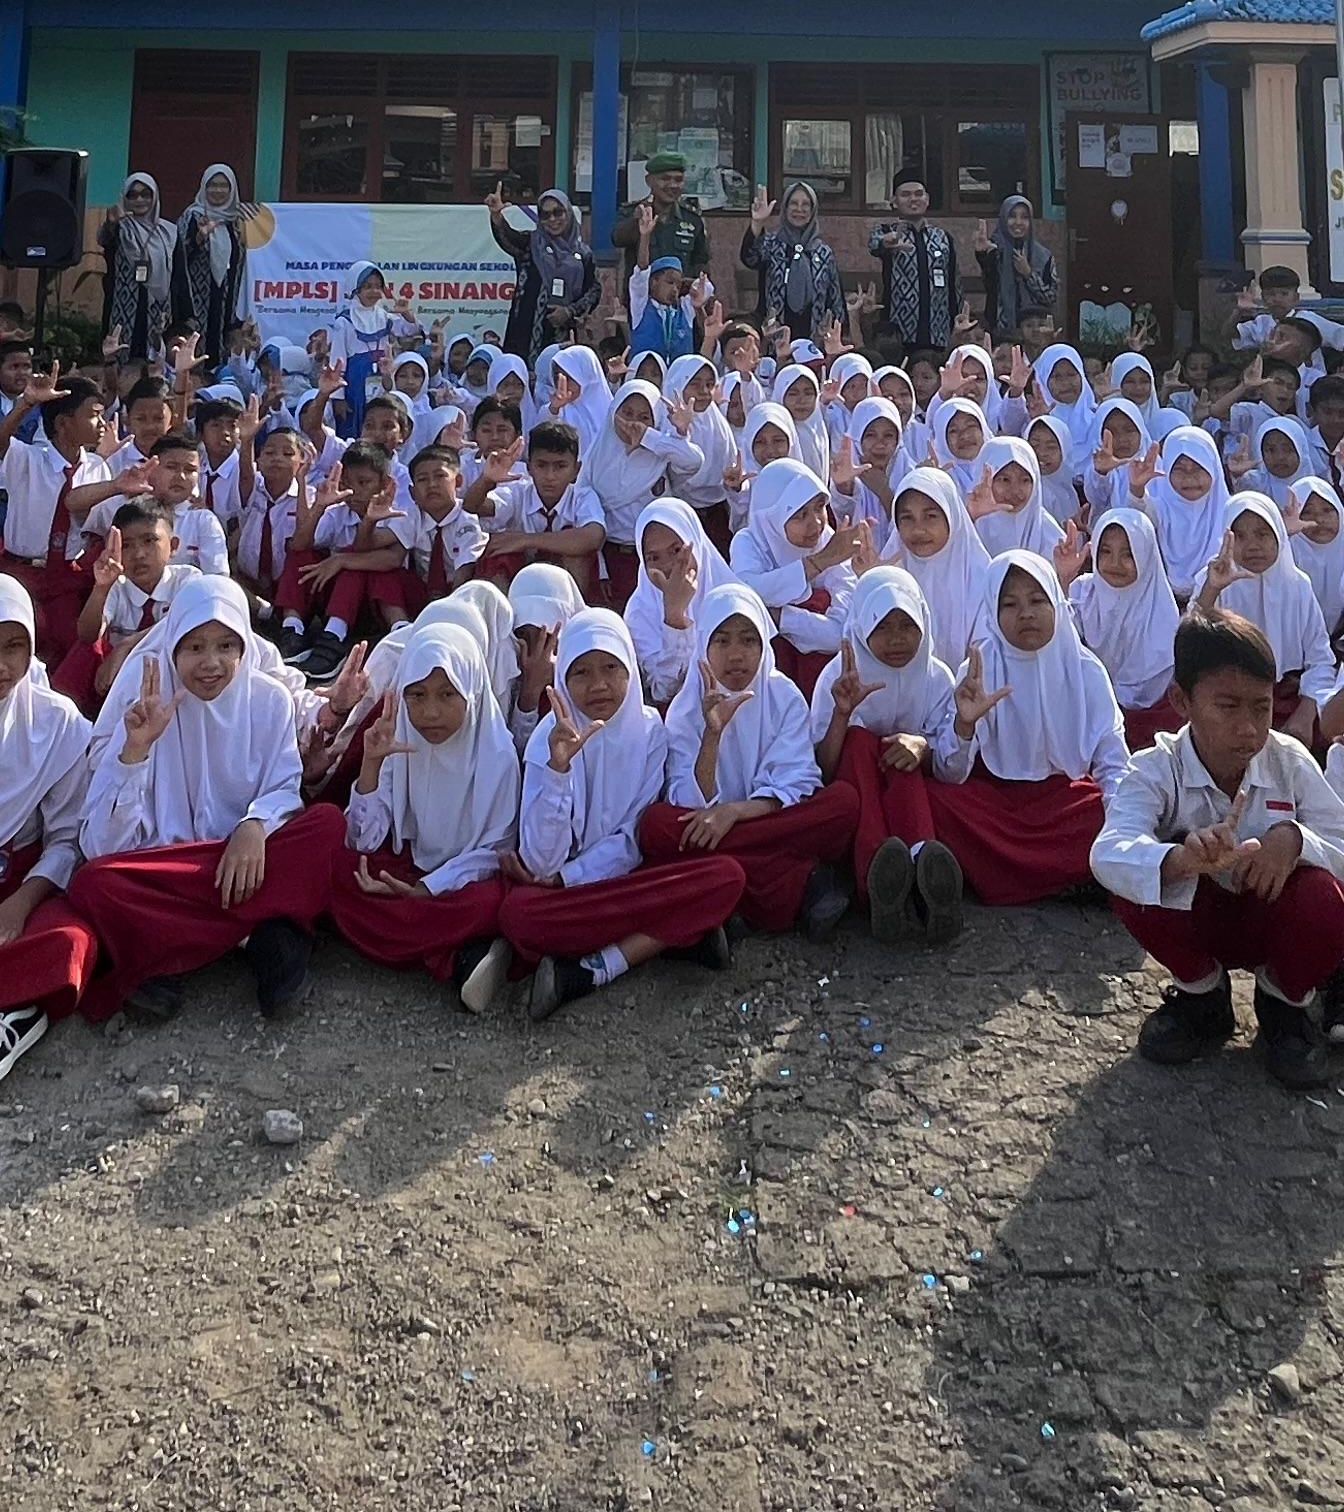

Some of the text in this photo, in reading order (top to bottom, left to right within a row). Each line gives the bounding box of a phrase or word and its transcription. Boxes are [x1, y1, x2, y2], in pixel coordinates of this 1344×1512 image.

[1056, 71, 1104, 85] STOP
[1057, 88, 1141, 100] BULLYING
[286, 261, 318, 270] MASA
[402, 262, 476, 271] LINGKUNGAN
[479, 262, 515, 271] SEKOL
[254, 280, 338, 303] [MPLS]
[399, 283, 414, 299] 4
[419, 283, 515, 300] SINANG
